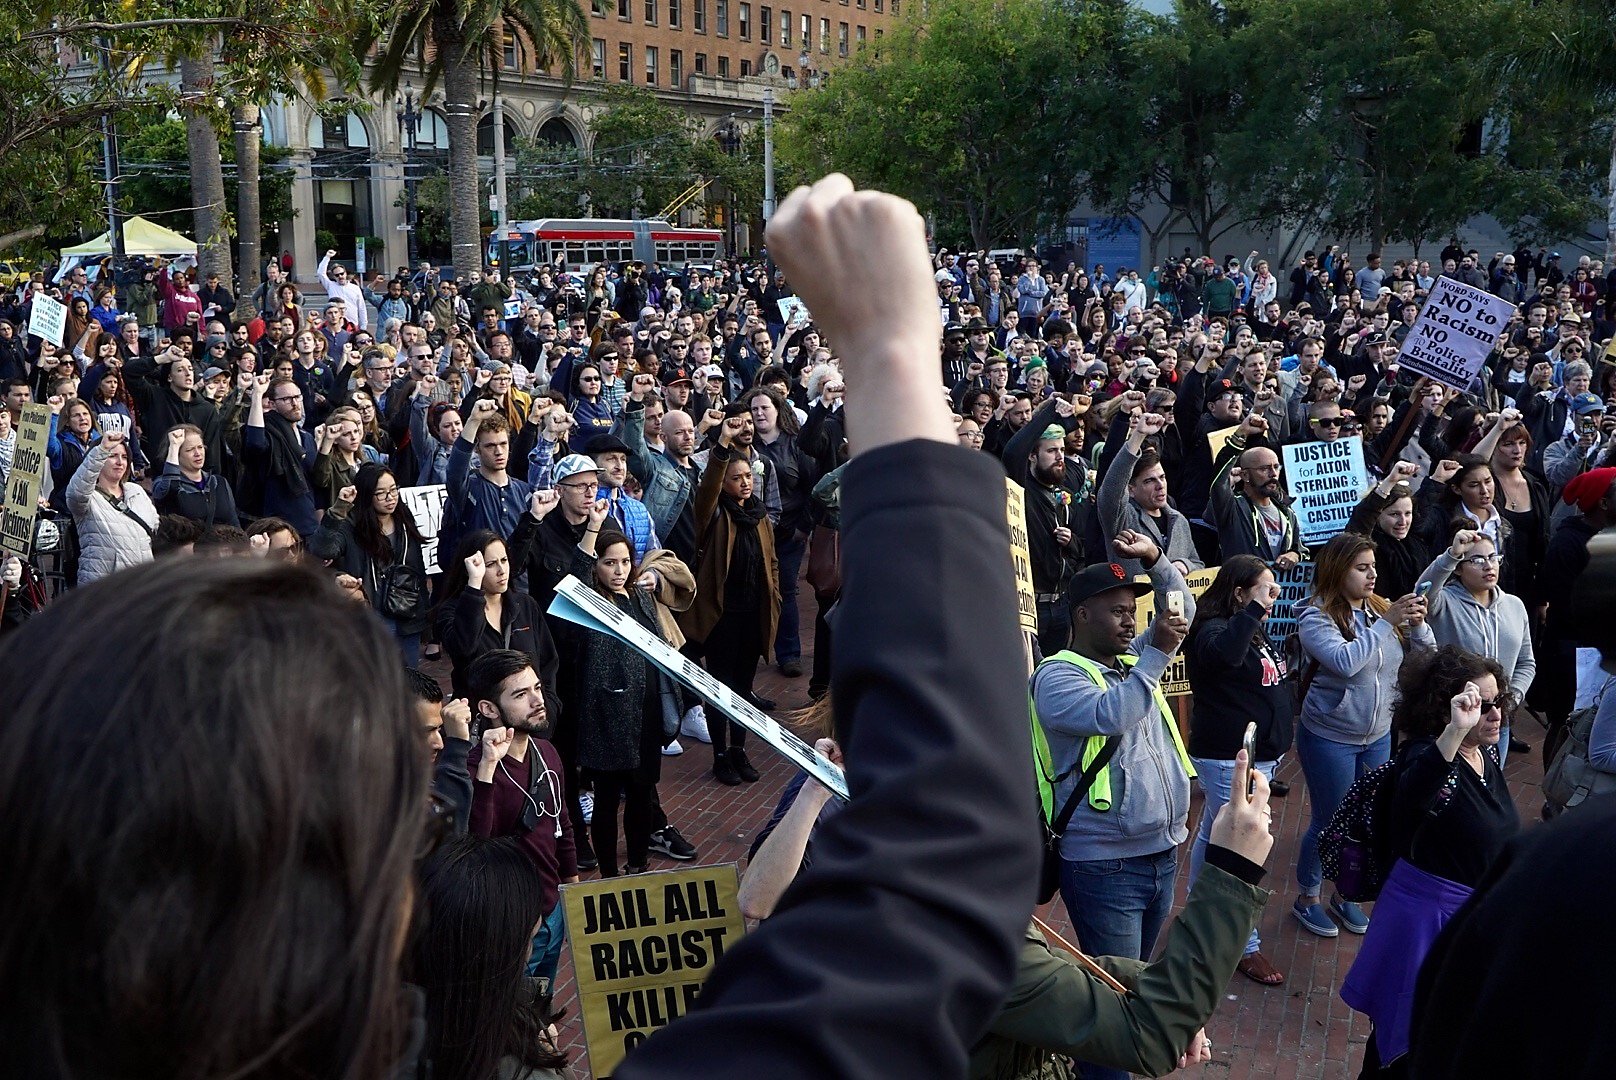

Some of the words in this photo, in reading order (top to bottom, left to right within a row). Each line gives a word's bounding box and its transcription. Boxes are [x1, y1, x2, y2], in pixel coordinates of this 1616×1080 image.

[1440, 281, 1467, 296] WORD
[1468, 291, 1491, 306] SAYS
[1439, 292, 1472, 314] NO
[1476, 308, 1497, 325] to
[1420, 324, 1448, 343] NO
[1424, 304, 1494, 344] Racism
[1410, 345, 1474, 380] Brutality
[1426, 340, 1467, 366] Police
[13, 444, 40, 474] Justice
[1294, 441, 1351, 463] JUSTICE
[1299, 467, 1314, 478] for
[1316, 459, 1350, 476] ALTON
[12, 479, 18, 504] 4
[1295, 476, 1348, 494] STERLING
[1351, 476, 1360, 486] &
[2, 507, 33, 540] Victims!
[1308, 506, 1354, 524] CASTILE
[1186, 577, 1210, 588] lando
[1276, 564, 1313, 583] TICE
[582, 888, 657, 934] JAIL
[664, 880, 726, 924] ALL
[590, 927, 727, 981] RACIST
[606, 983, 703, 1032] KILLE
